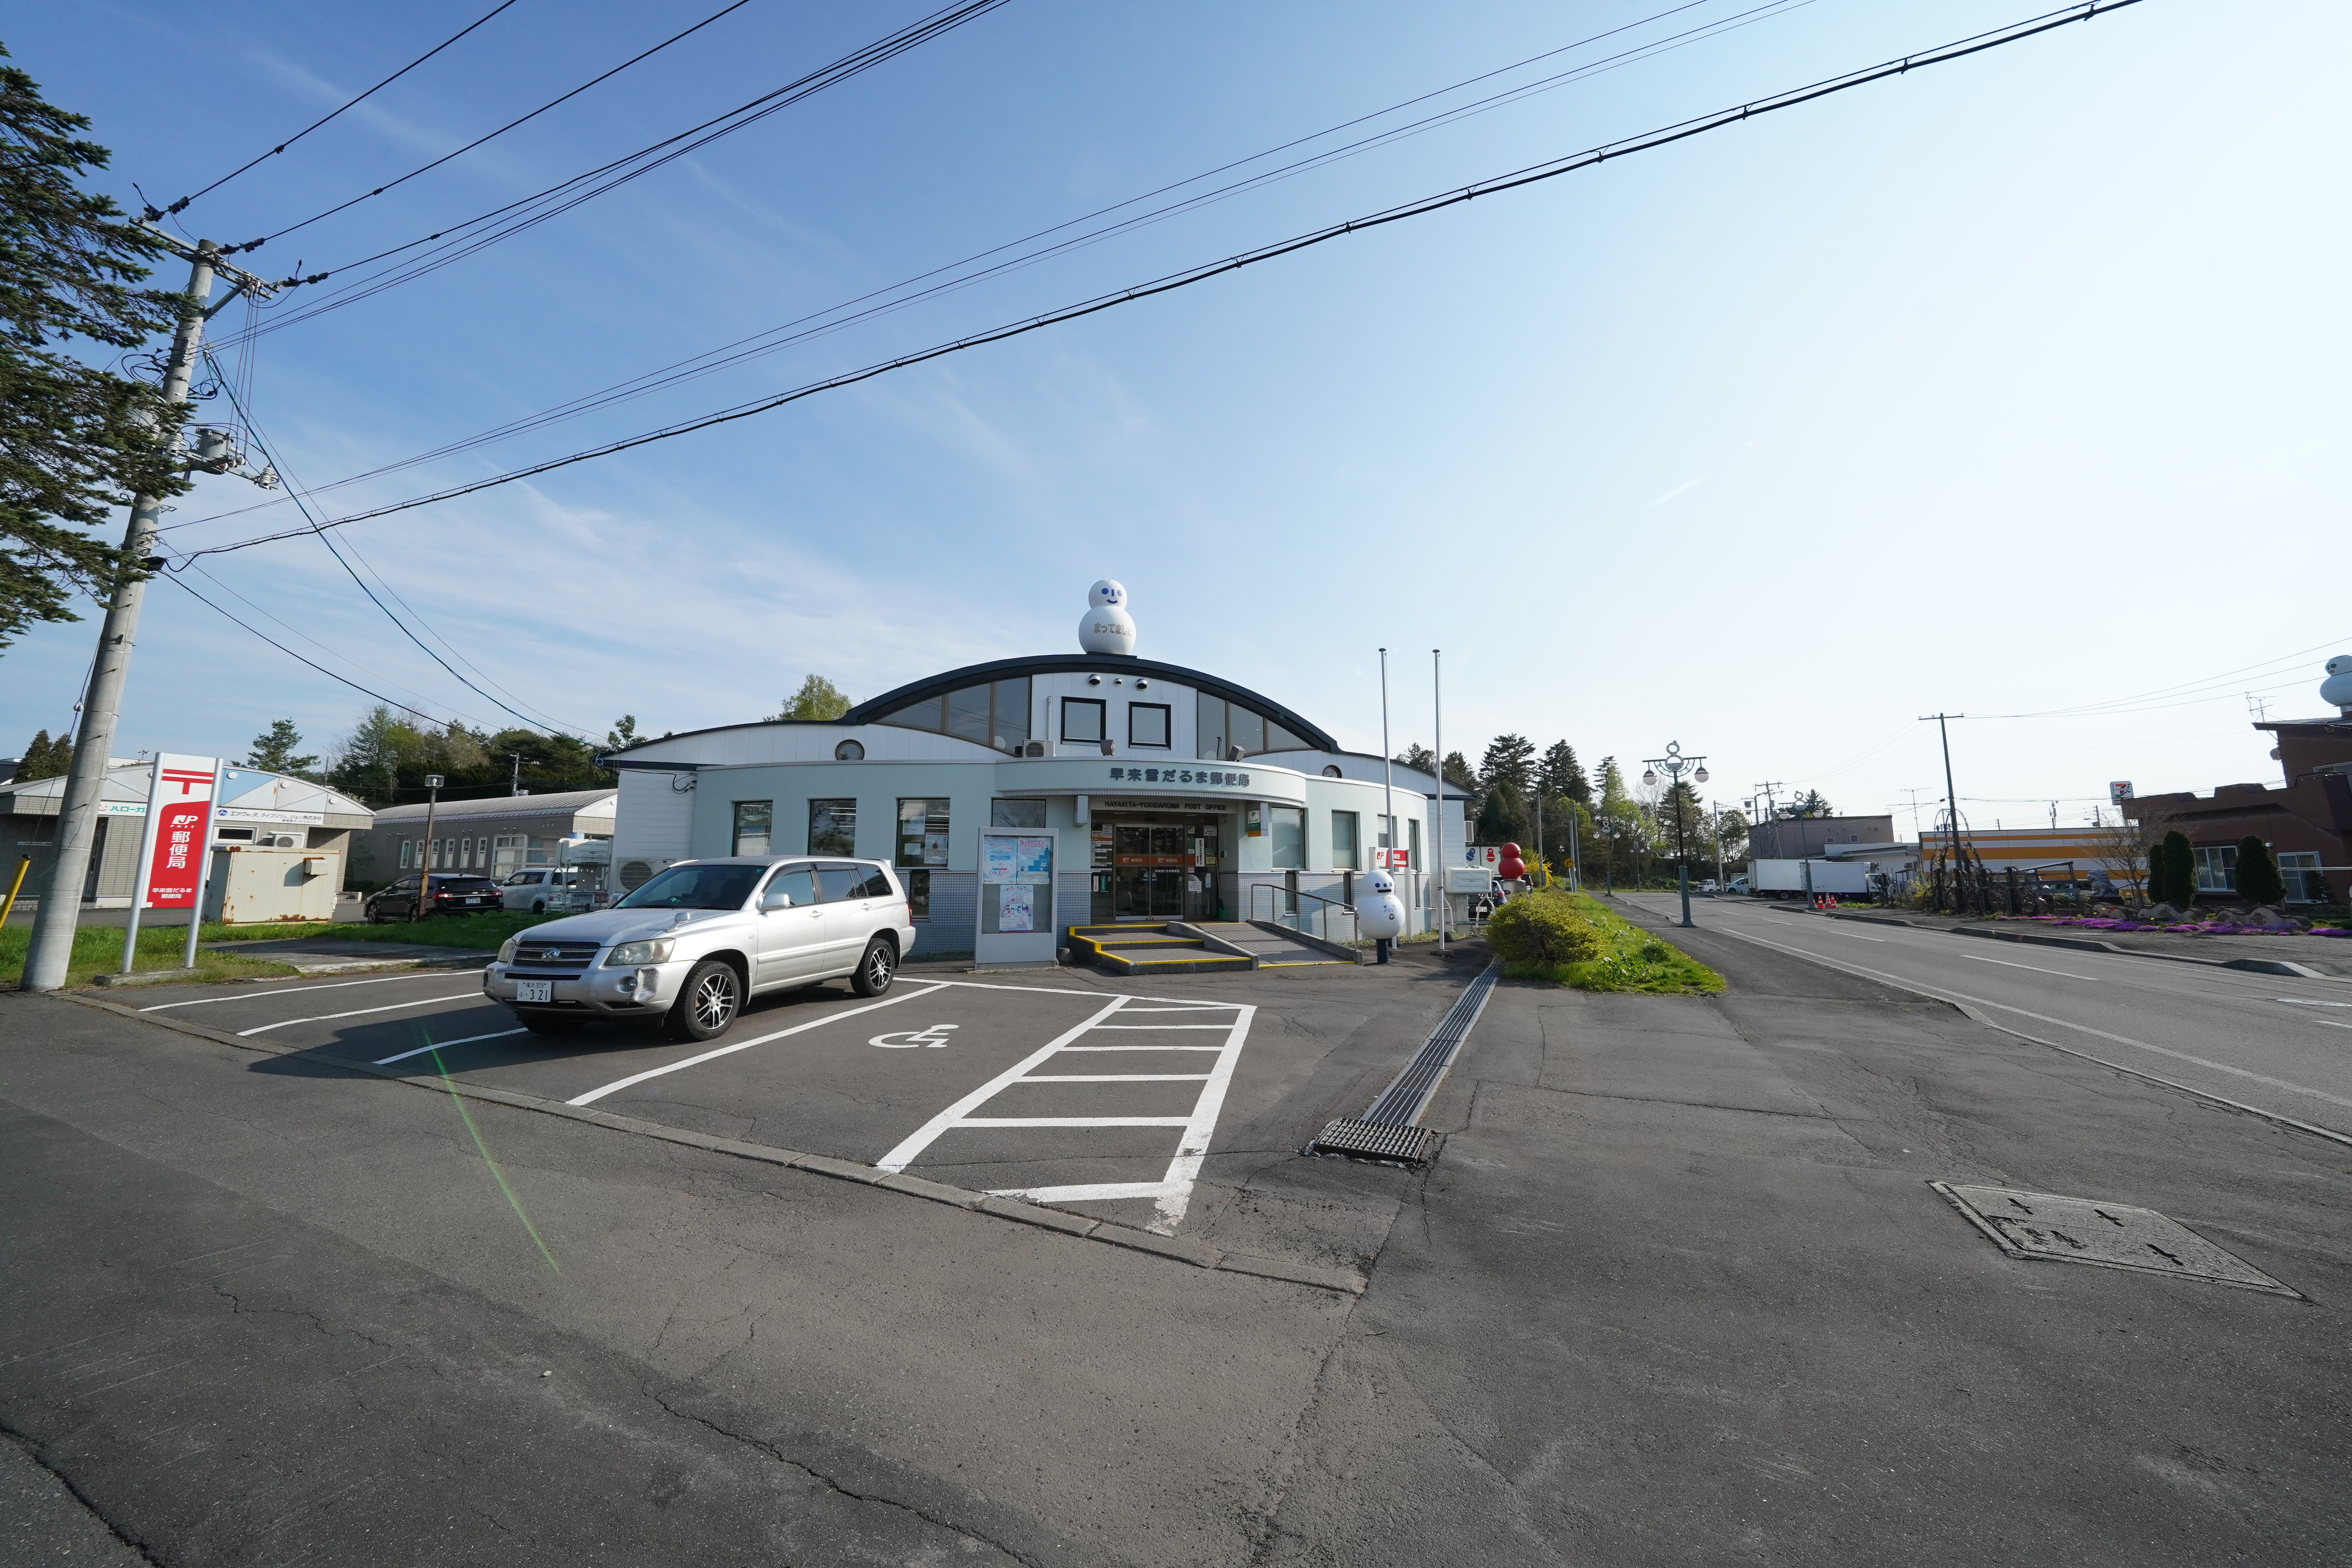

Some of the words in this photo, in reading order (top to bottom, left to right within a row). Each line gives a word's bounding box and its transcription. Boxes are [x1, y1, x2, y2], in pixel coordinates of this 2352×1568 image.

[1094, 622, 1132, 637] まってました
[1109, 768, 1250, 787] 早来雪だるま郵便局
[1105, 801, 1180, 809] HAYAKITA-YUKIDARUMA
[166, 831, 191, 869] 郵便局
